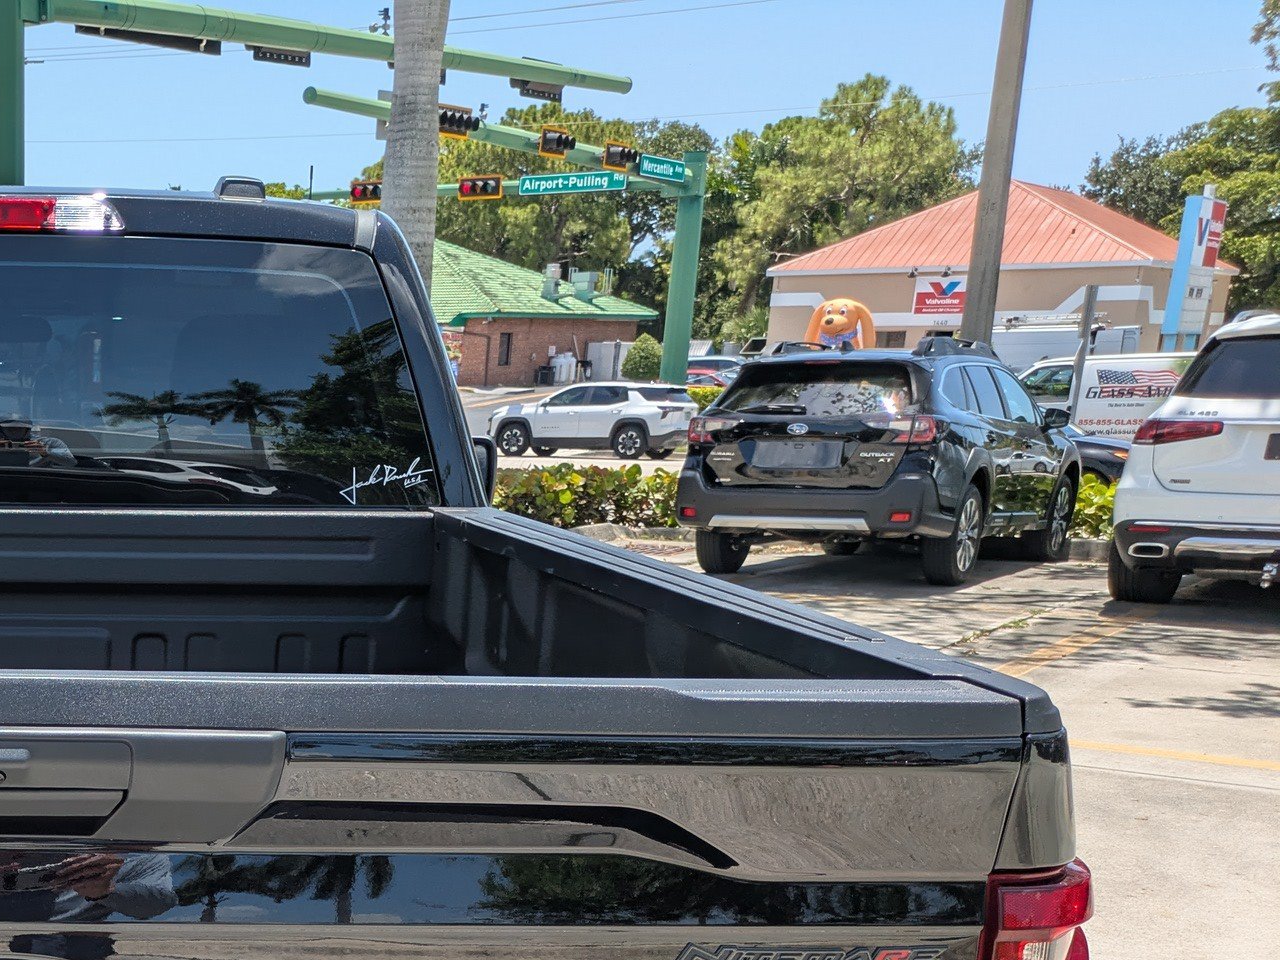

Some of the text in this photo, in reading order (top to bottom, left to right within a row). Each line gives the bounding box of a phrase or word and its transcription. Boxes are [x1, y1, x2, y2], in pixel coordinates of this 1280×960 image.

[642, 159, 674, 176] Mercantile
[522, 173, 624, 192] Airport-Pulling Rd
